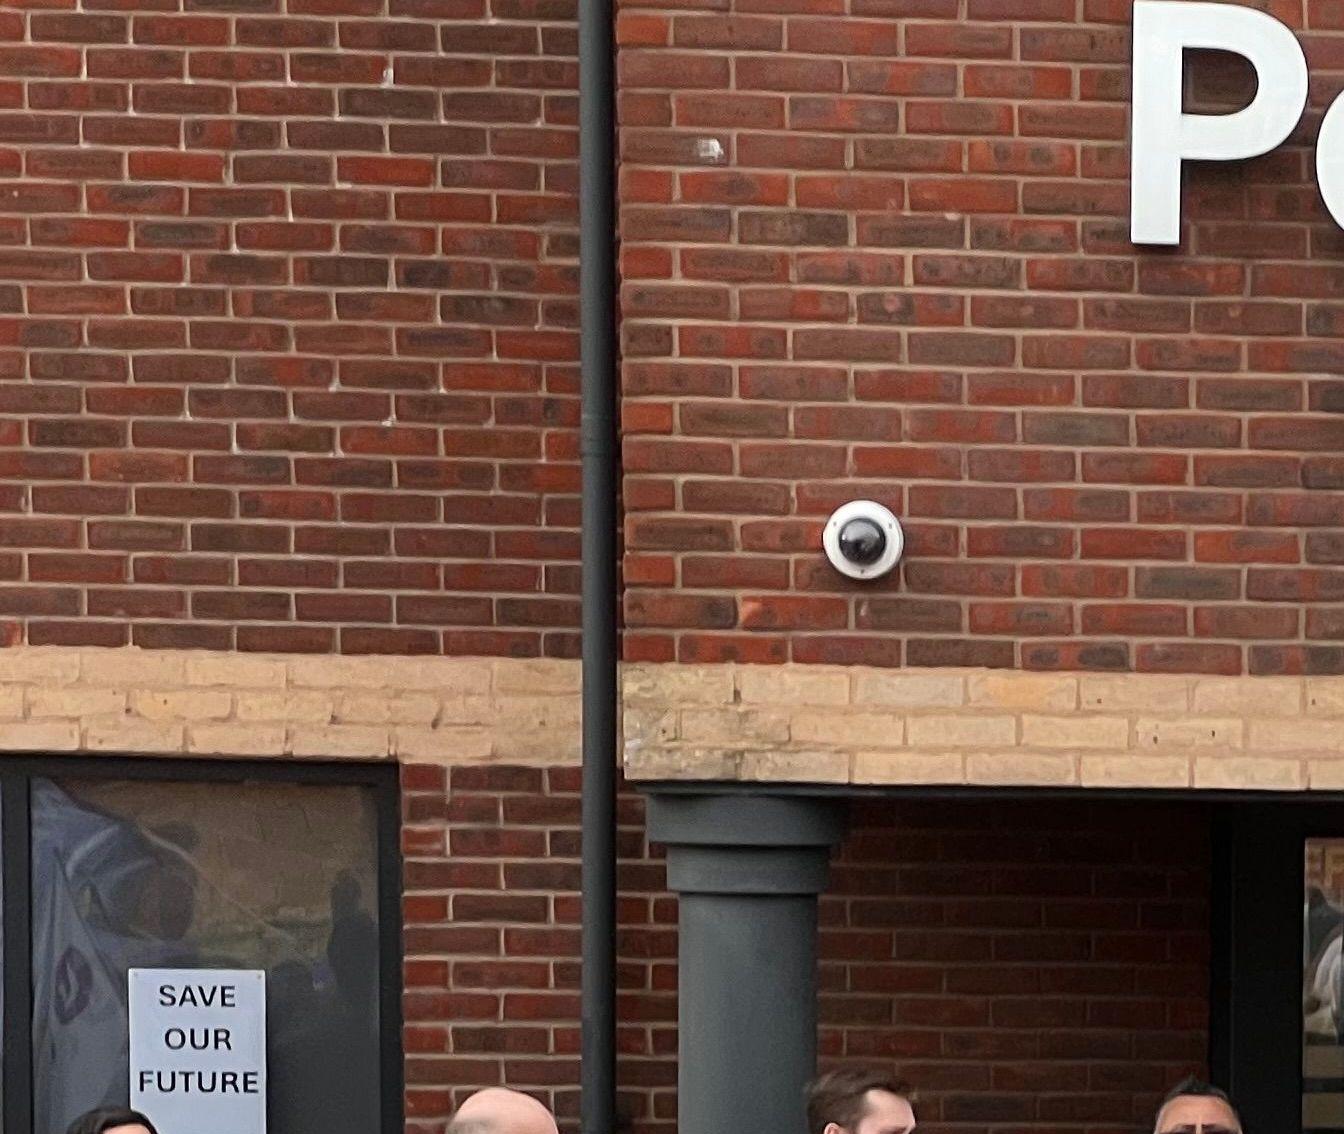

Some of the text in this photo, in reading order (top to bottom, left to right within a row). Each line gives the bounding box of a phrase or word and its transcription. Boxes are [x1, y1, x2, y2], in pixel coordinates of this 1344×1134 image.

[159, 984, 236, 1008] SAVE
[164, 1028, 232, 1051] OUR
[139, 1070, 260, 1094] FUTURE
